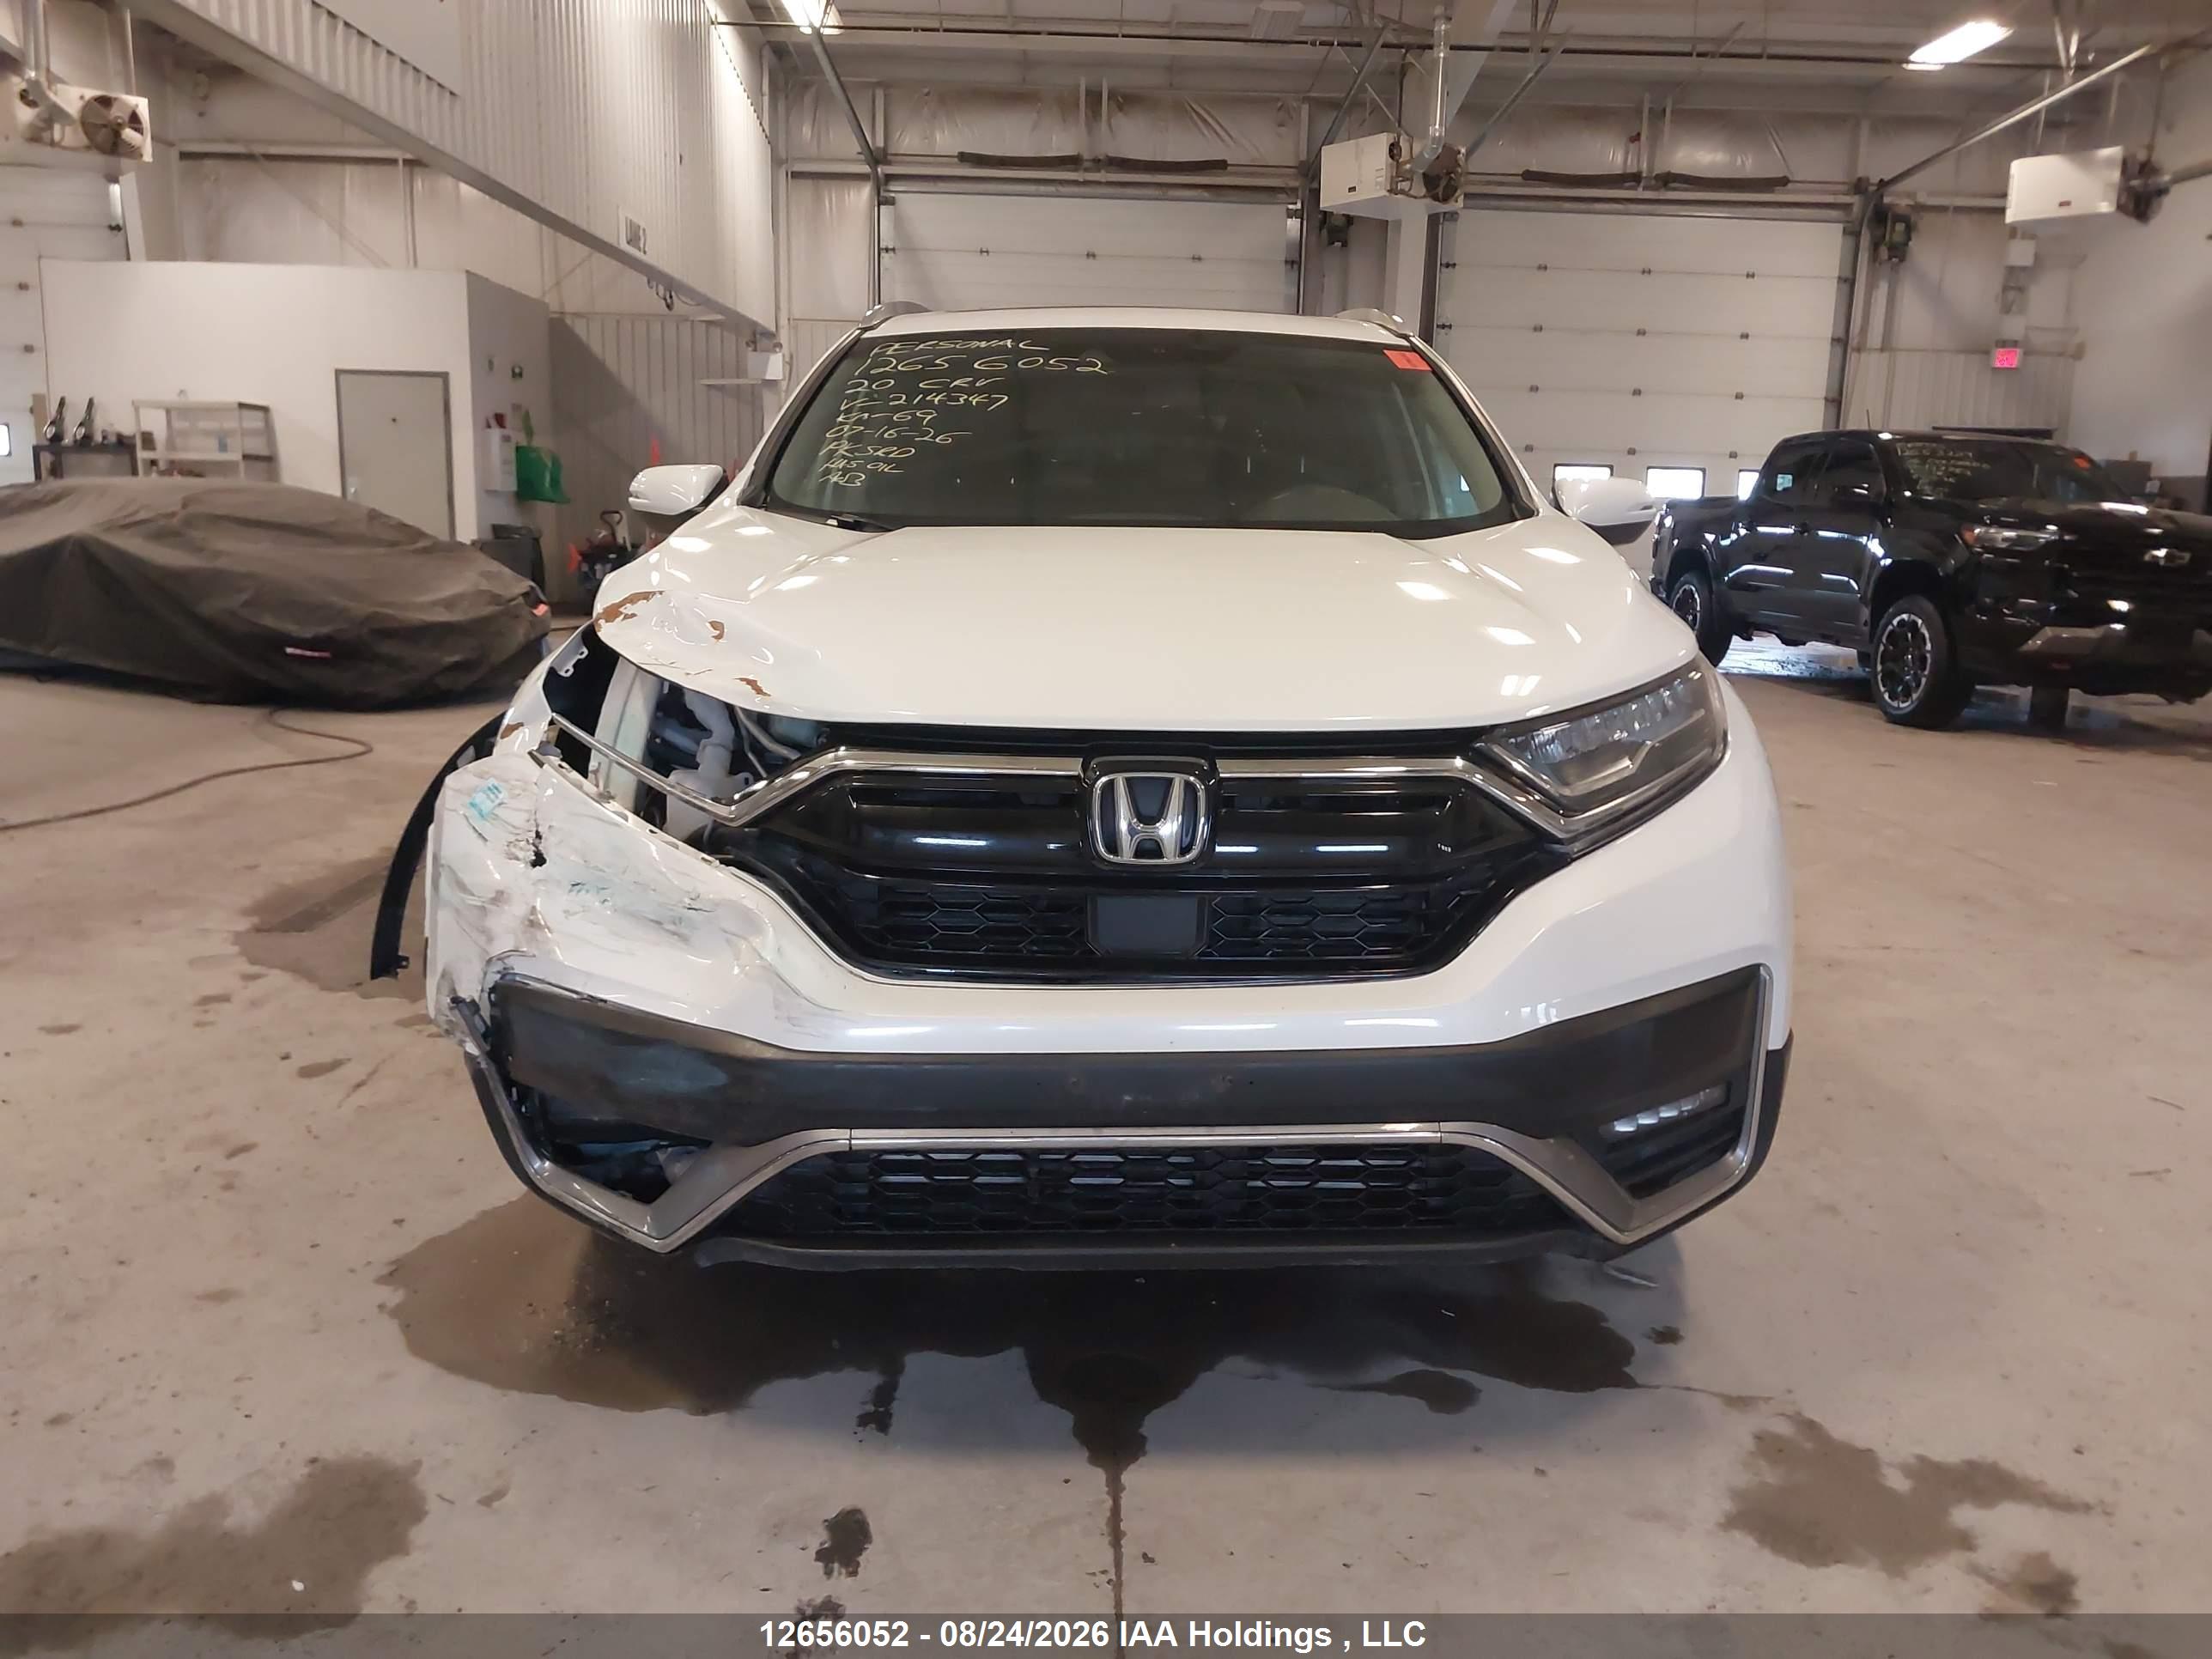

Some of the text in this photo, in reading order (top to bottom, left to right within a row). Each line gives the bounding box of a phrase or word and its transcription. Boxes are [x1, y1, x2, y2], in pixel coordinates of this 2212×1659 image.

[869, 338, 1050, 356] PERSONAL
[844, 377, 1006, 394] 20 CRV
